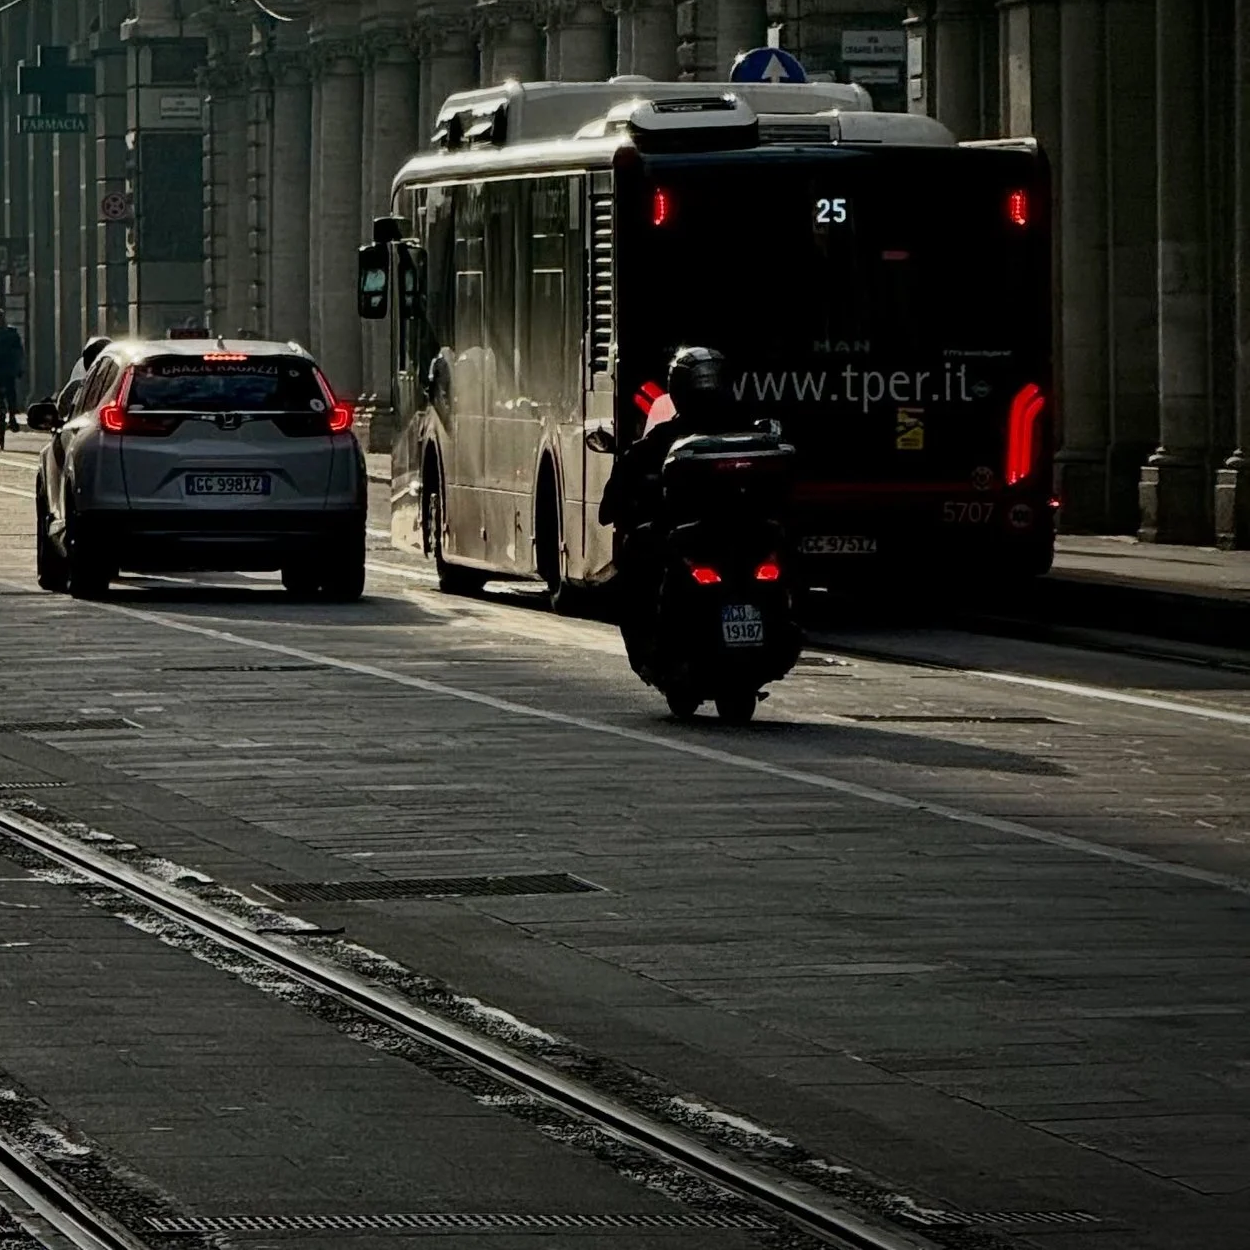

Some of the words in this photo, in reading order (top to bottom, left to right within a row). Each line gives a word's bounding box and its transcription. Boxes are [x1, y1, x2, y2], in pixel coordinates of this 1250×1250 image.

[23, 119, 84, 131] FARMACIA
[816, 198, 846, 223] 25
[943, 501, 995, 523] 5707
